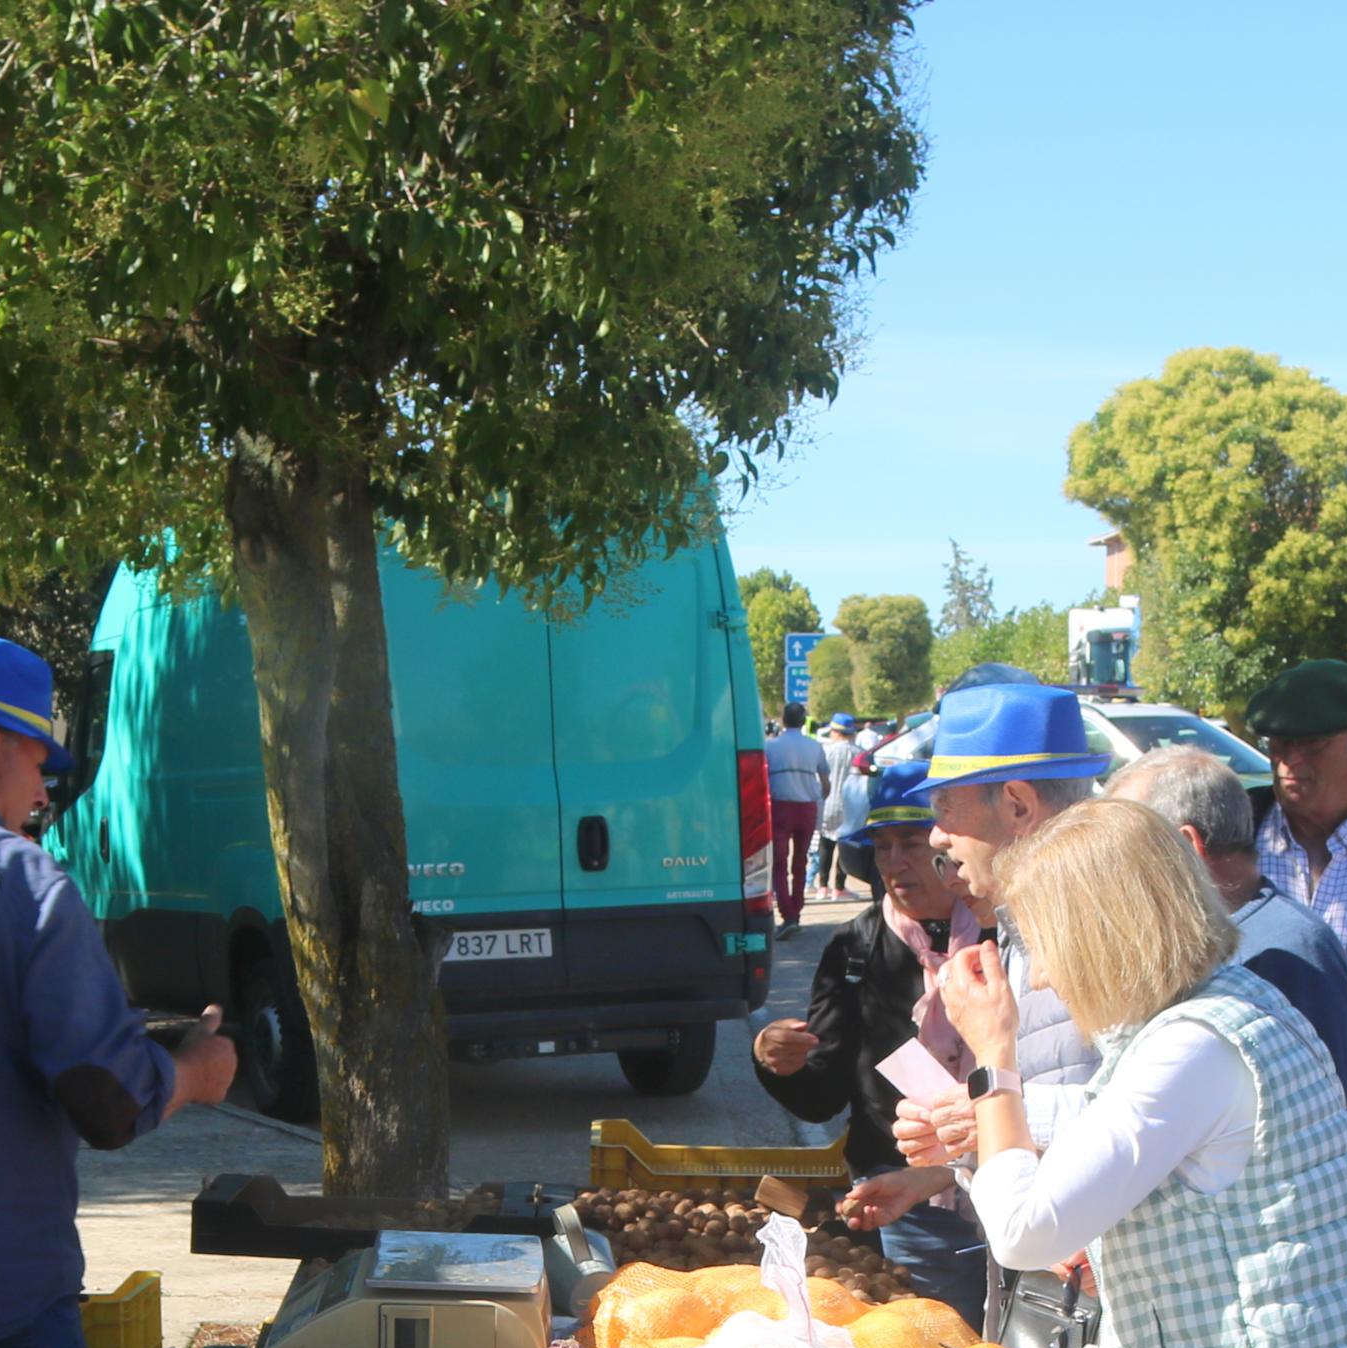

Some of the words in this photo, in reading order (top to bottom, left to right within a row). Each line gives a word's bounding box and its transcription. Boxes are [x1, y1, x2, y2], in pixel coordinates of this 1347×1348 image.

[662, 856, 708, 867] DAILY
[408, 862, 465, 877] VECO
[412, 900, 455, 912] VECO
[505, 933, 546, 955] LRT
